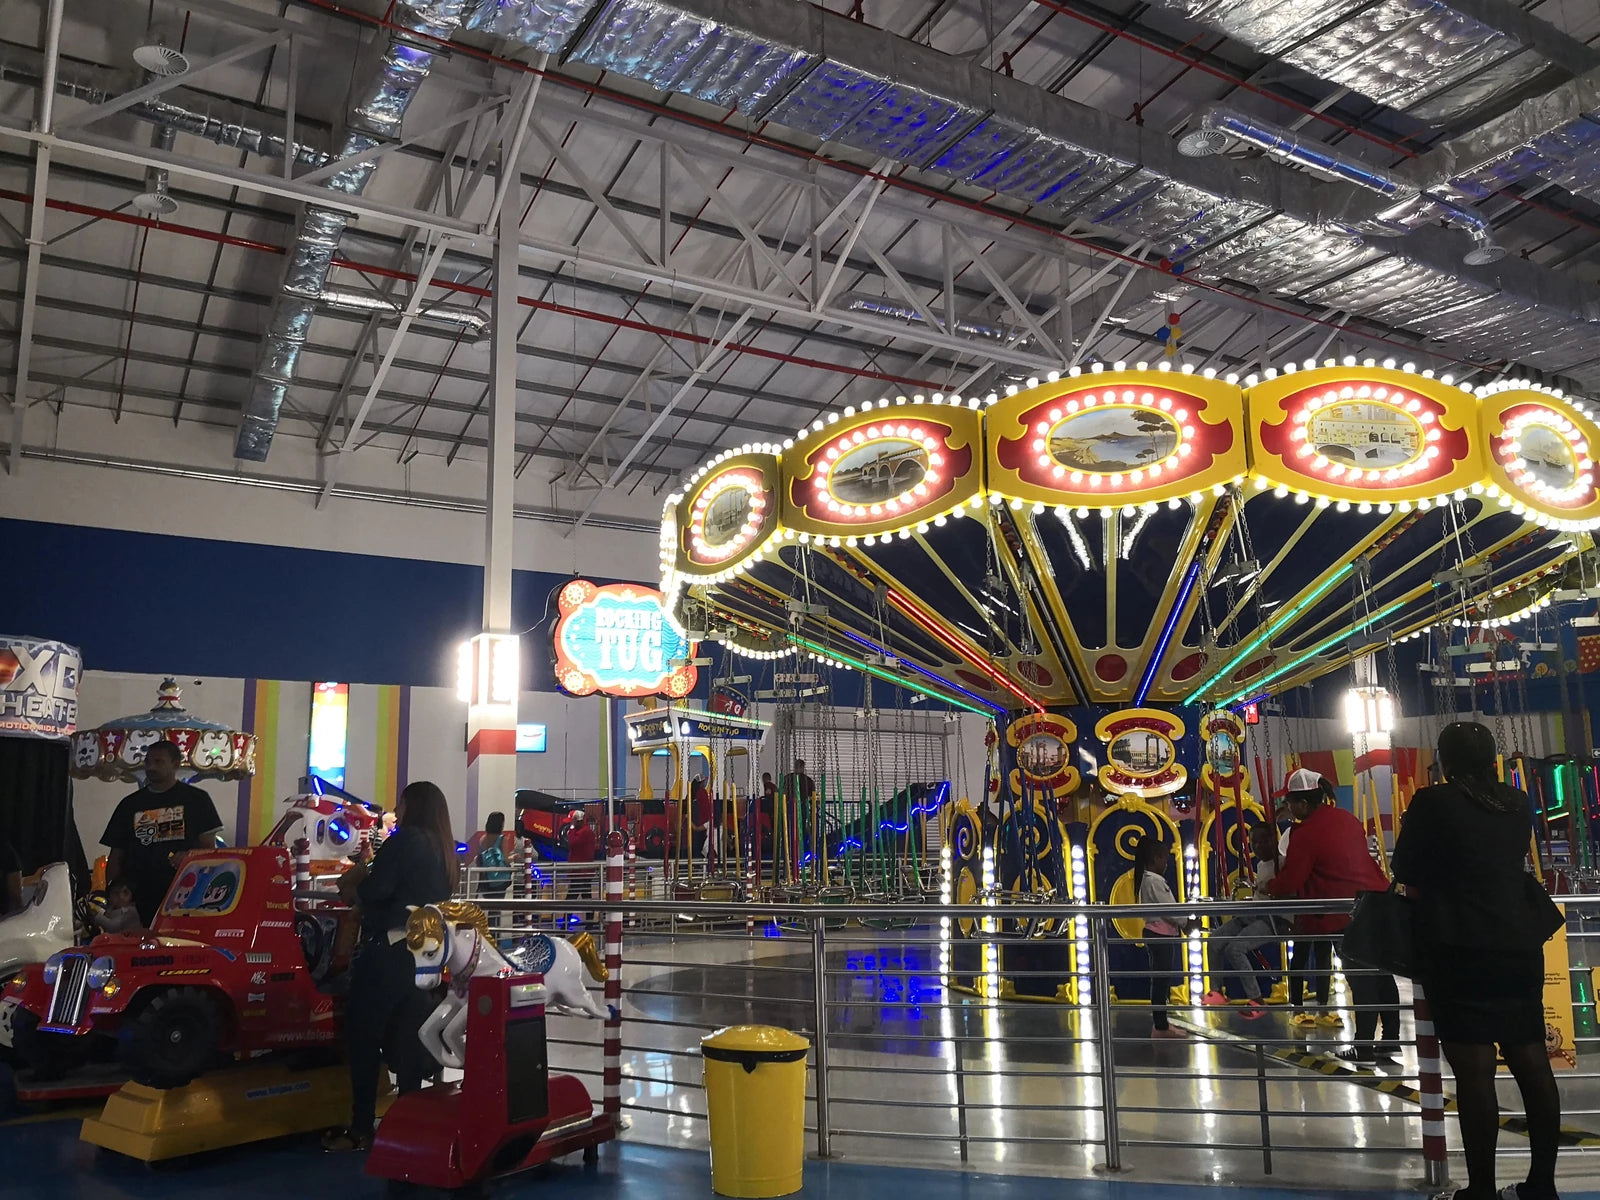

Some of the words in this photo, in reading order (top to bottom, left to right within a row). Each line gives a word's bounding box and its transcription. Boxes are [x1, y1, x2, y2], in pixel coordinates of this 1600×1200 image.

[594, 607, 663, 631] ROCKING
[594, 629, 663, 672] TUG
[159, 968, 211, 976] LEADER
